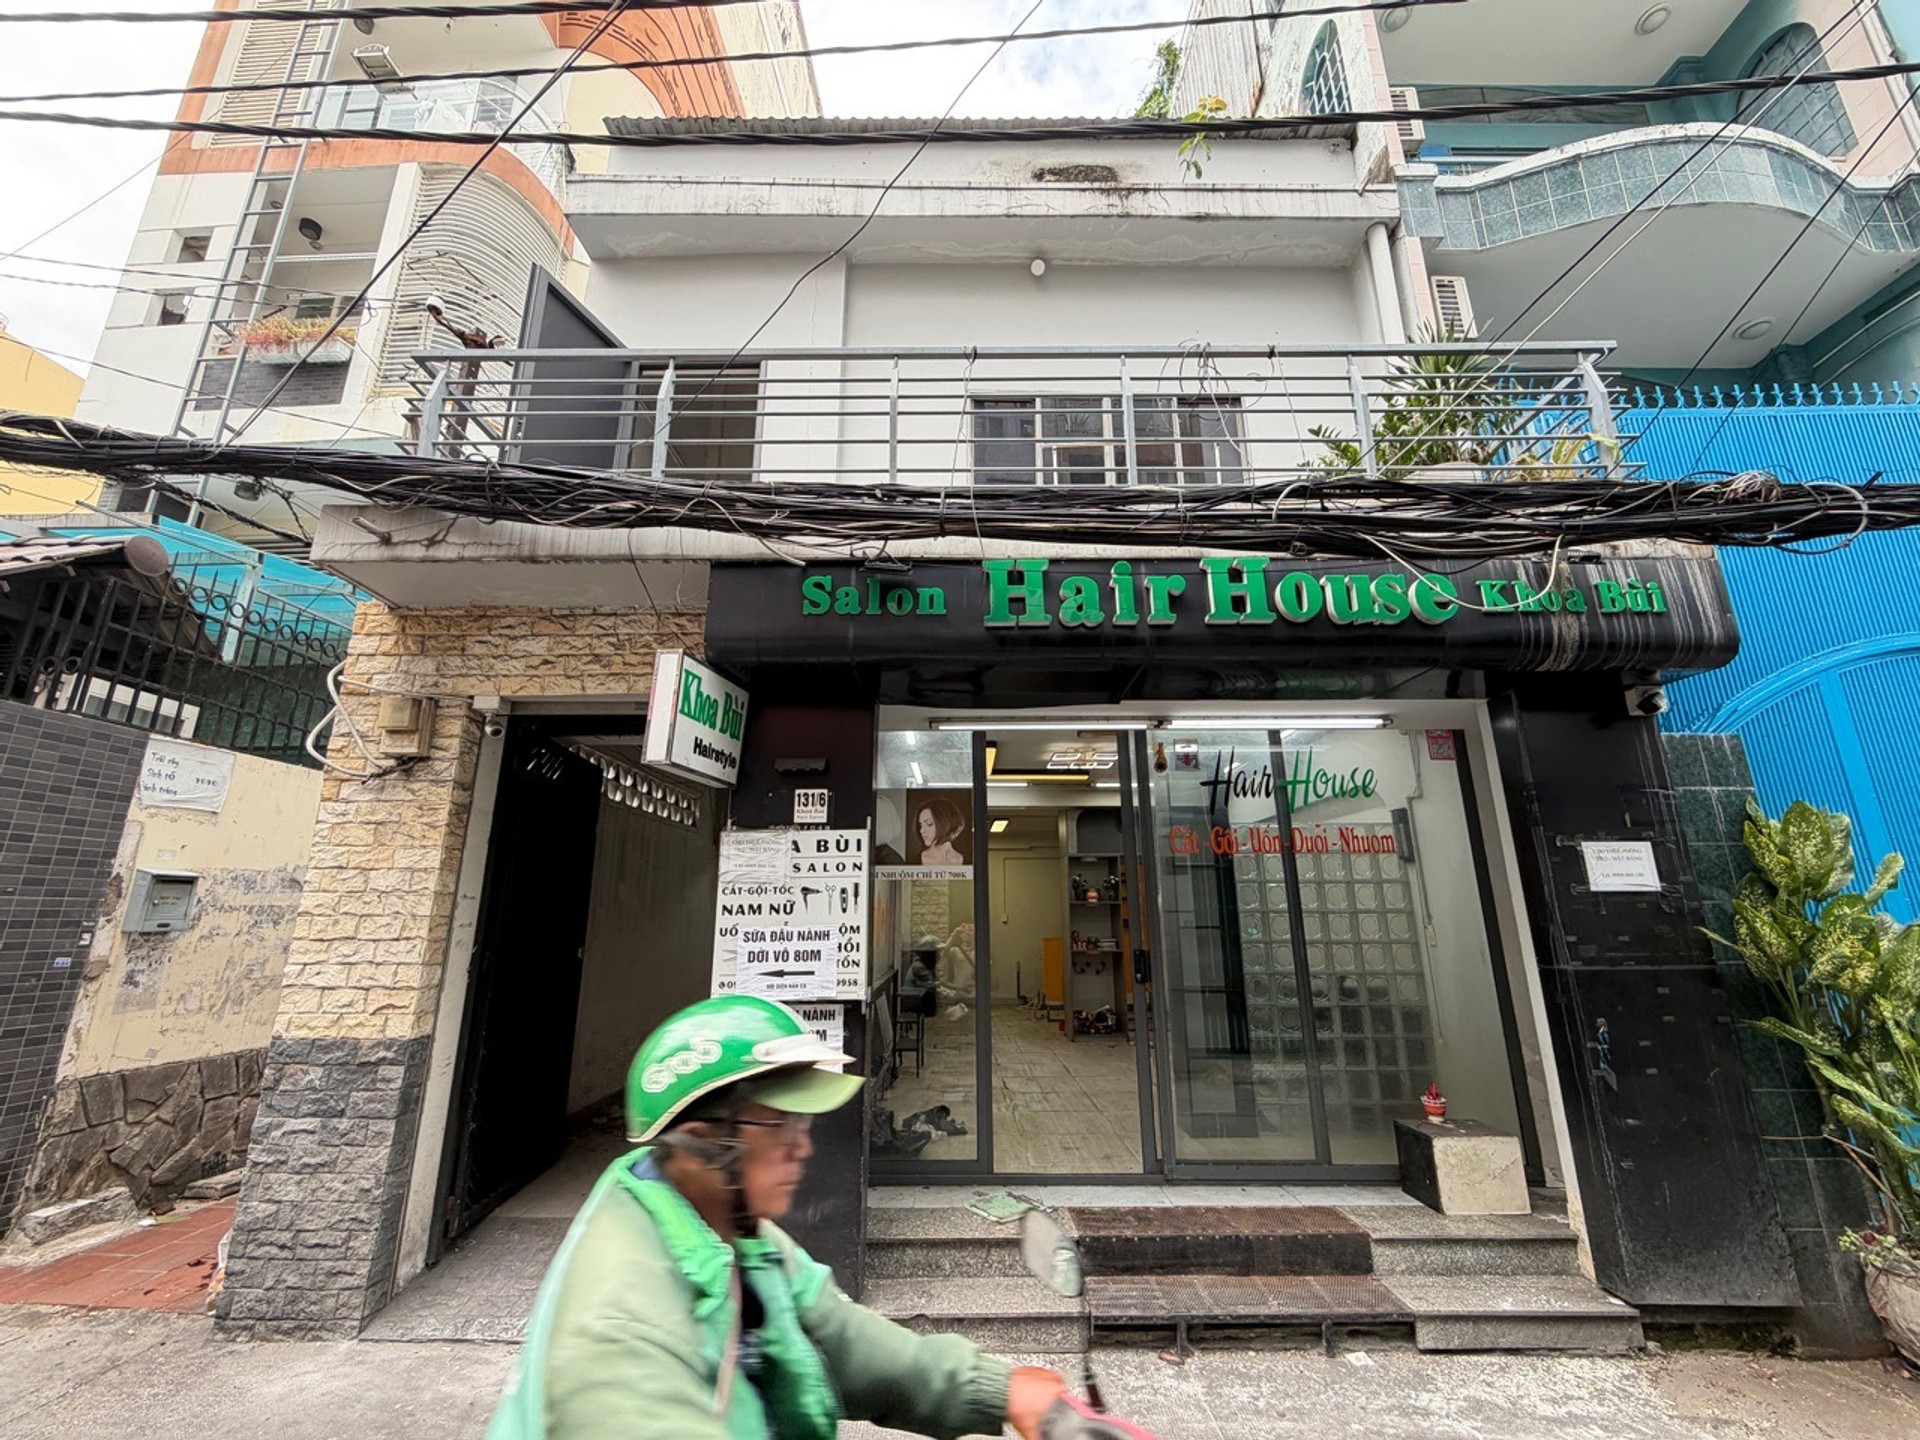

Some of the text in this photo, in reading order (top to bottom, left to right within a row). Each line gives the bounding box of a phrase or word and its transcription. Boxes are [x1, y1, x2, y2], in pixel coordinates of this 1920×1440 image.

[802, 556, 1667, 627] Salon Hair House Khoa Bùi
[679, 668, 745, 742] Khoa Bùi
[693, 736, 738, 769] Hairstyle
[1200, 746, 1378, 815] Hair House
[791, 839, 801, 853] A
[816, 834, 862, 853] BÙI
[1249, 824, 1284, 854] Uốn
[792, 861, 862, 873] SALON
[721, 900, 796, 916] NAM NỮ
[719, 922, 860, 937] UỐ ỘM
[743, 927, 830, 945] SỮA ĐẬU NÀNH
[748, 946, 821, 963] DỜI VÔ 80M
[803, 1006, 836, 1021] NÀNH
